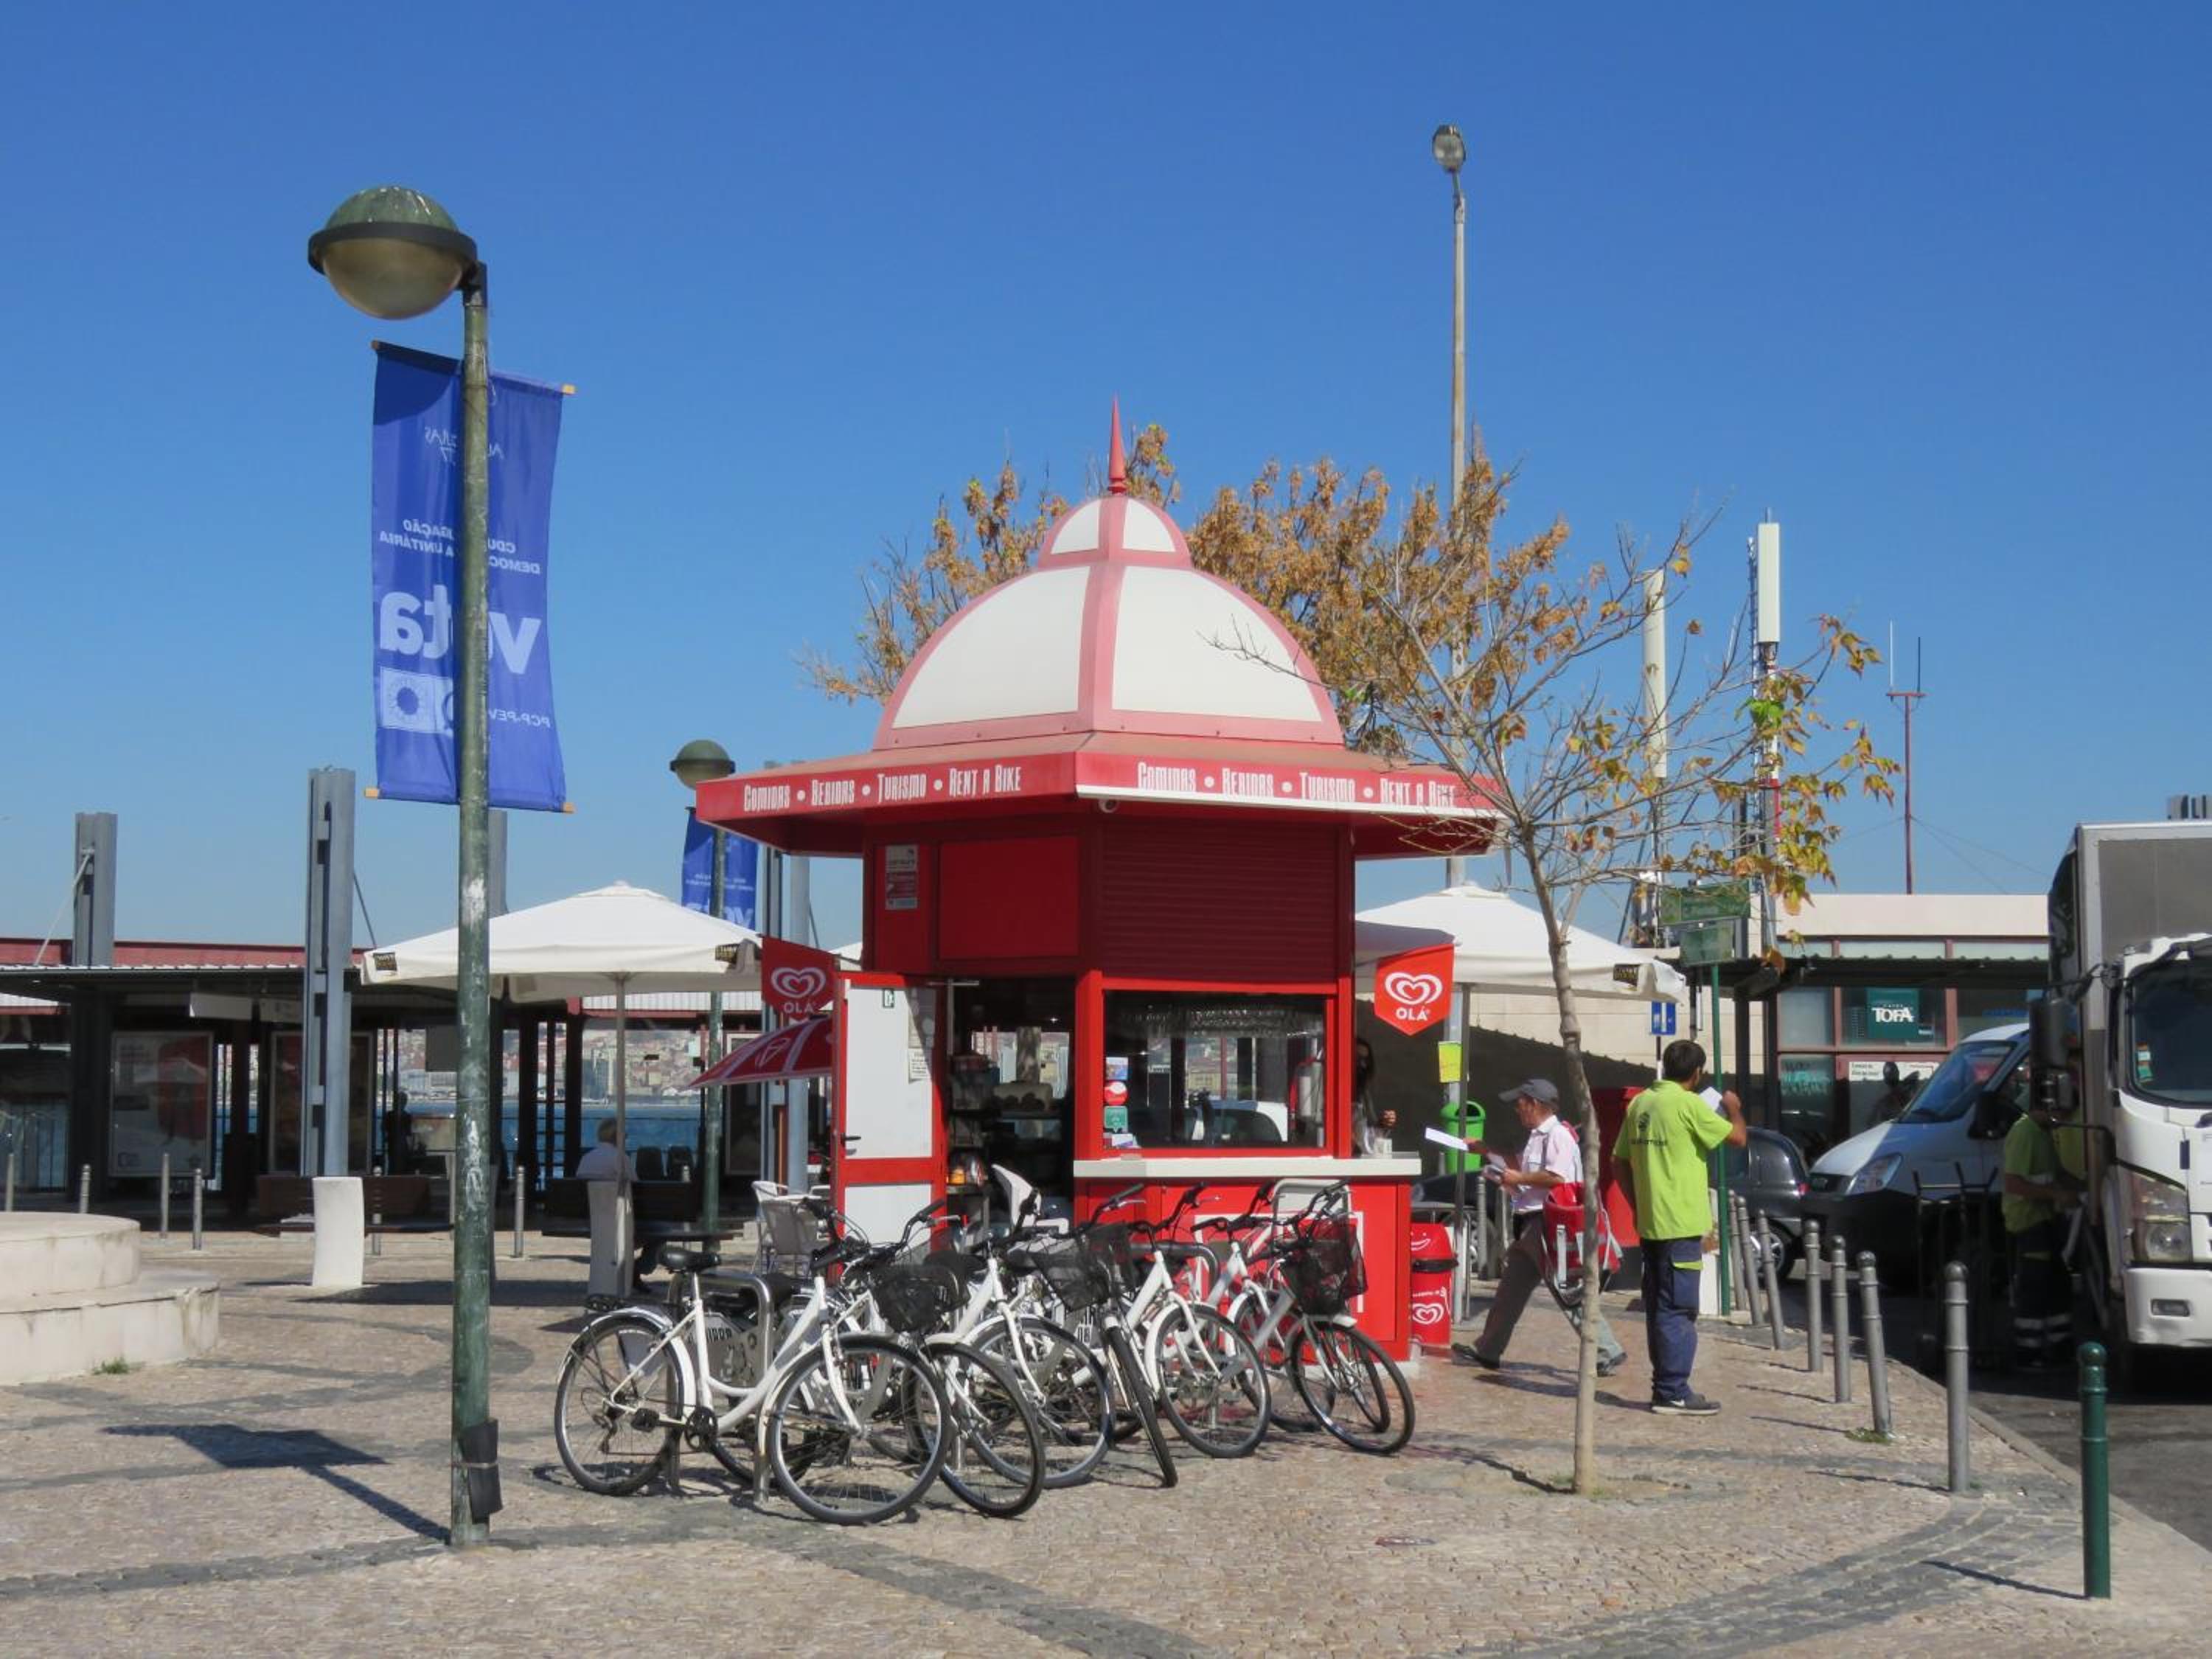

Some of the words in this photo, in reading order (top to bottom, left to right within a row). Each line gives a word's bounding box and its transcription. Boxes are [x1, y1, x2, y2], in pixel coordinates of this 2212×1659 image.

[877, 773, 927, 804] TURISMO
[949, 768, 978, 798] RENT
[982, 768, 991, 796] A
[995, 764, 1021, 793] BIKE
[1380, 778, 1410, 805] RENT
[1396, 1006, 1428, 1020] OLÁ
